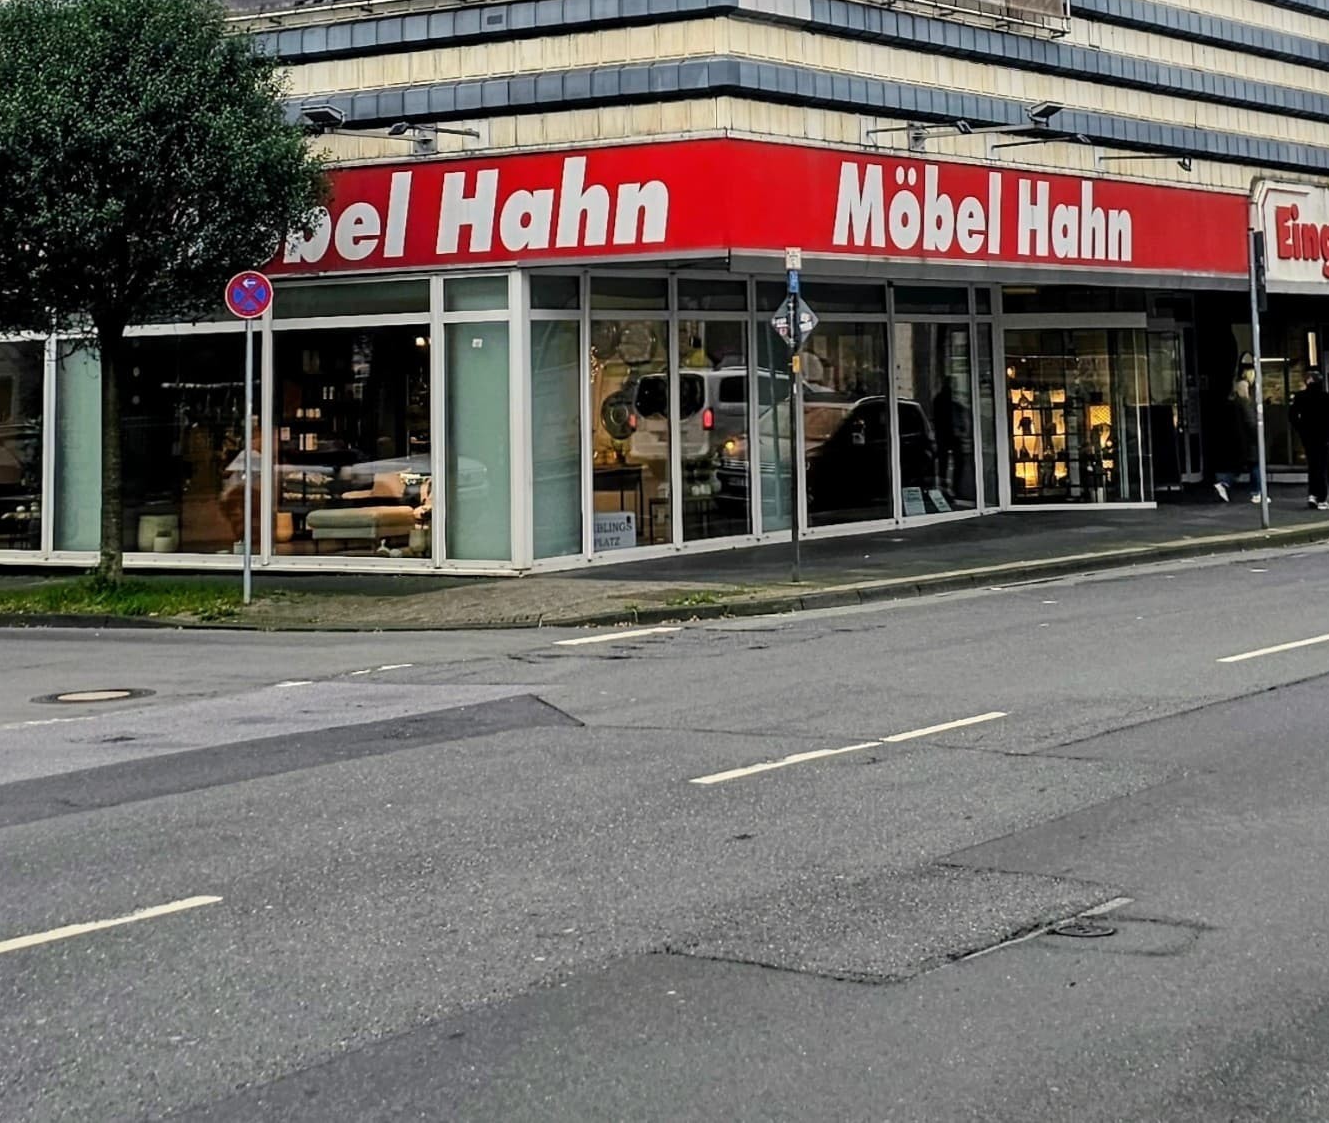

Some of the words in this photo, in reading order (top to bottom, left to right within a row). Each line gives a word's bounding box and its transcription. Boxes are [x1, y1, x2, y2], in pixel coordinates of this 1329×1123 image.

[275, 171, 412, 264] bel
[436, 156, 668, 255] Hahn
[832, 161, 1002, 255] Möbel
[1017, 179, 1132, 262] Hahn
